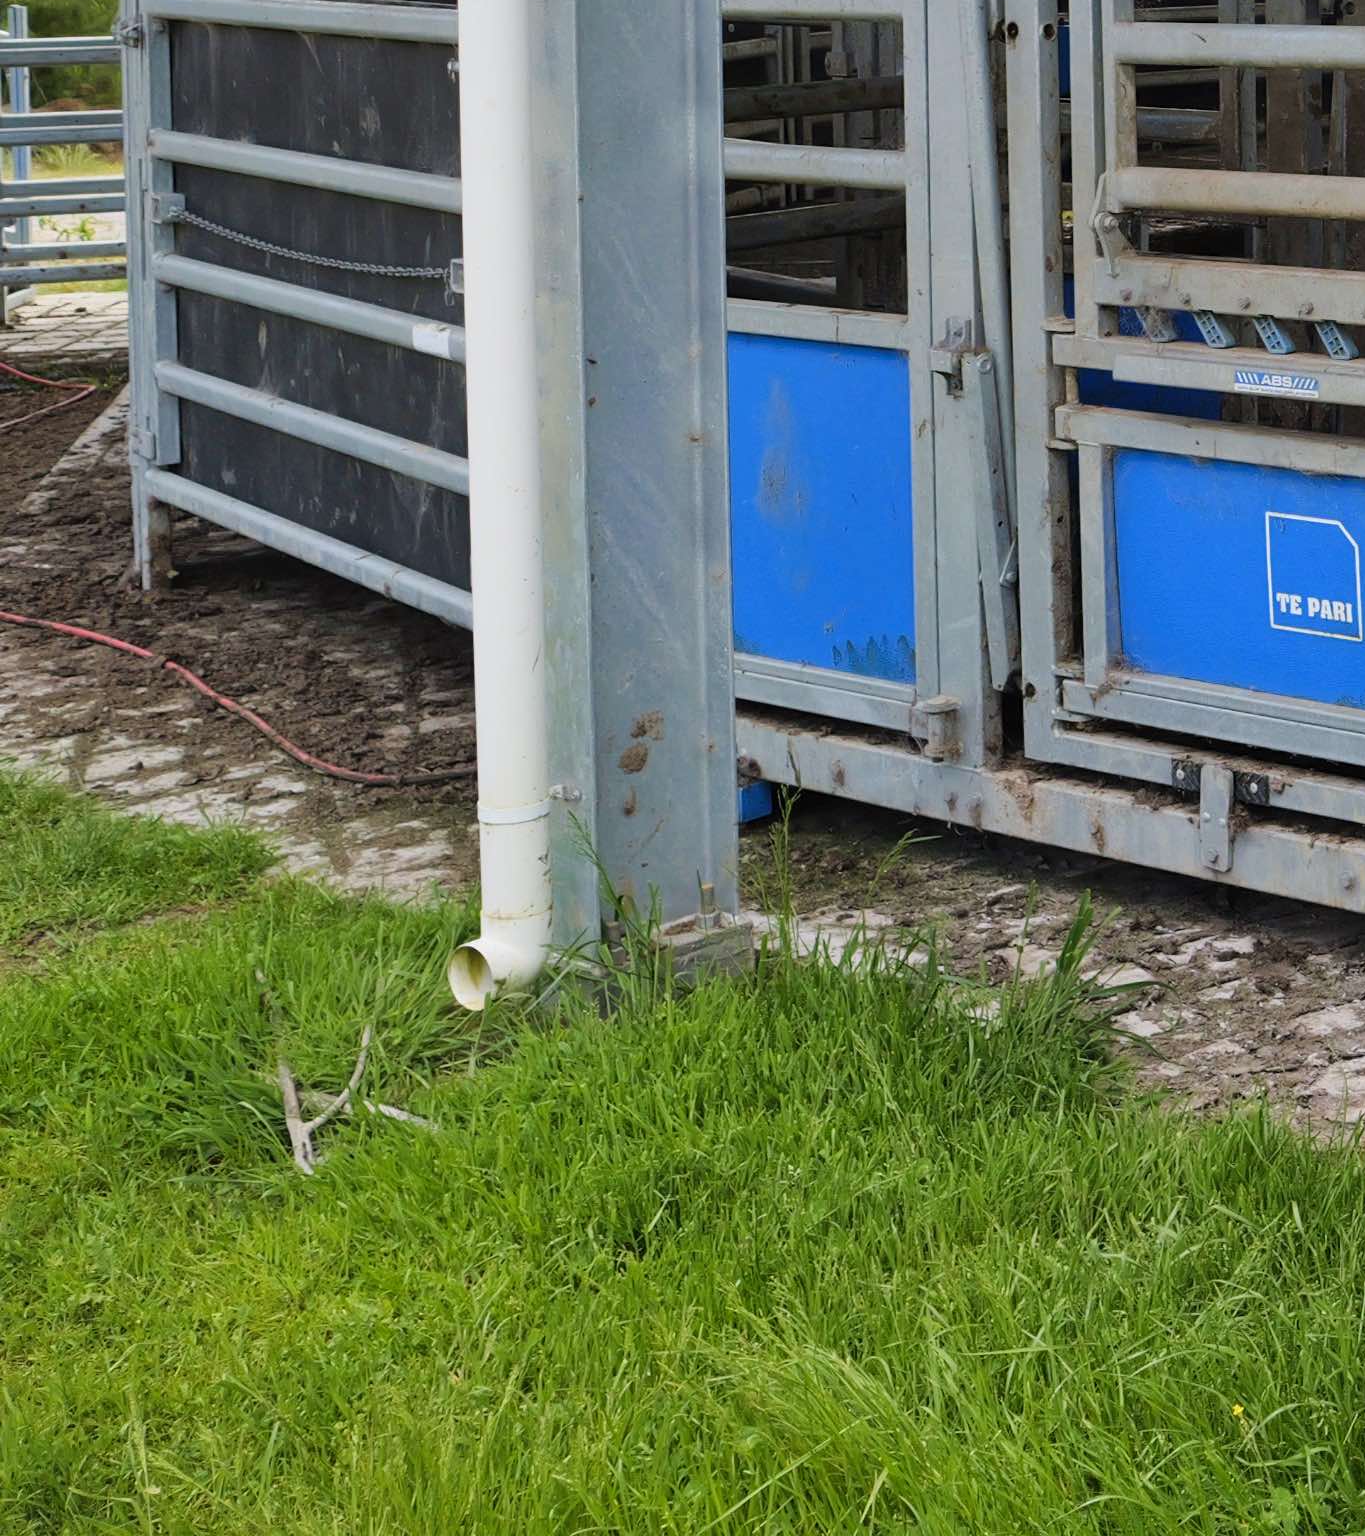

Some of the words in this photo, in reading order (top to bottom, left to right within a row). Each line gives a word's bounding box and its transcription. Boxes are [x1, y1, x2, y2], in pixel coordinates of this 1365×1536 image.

[1261, 374, 1293, 388] ABS
[1276, 592, 1302, 616] TE
[1307, 597, 1353, 624] PARI
